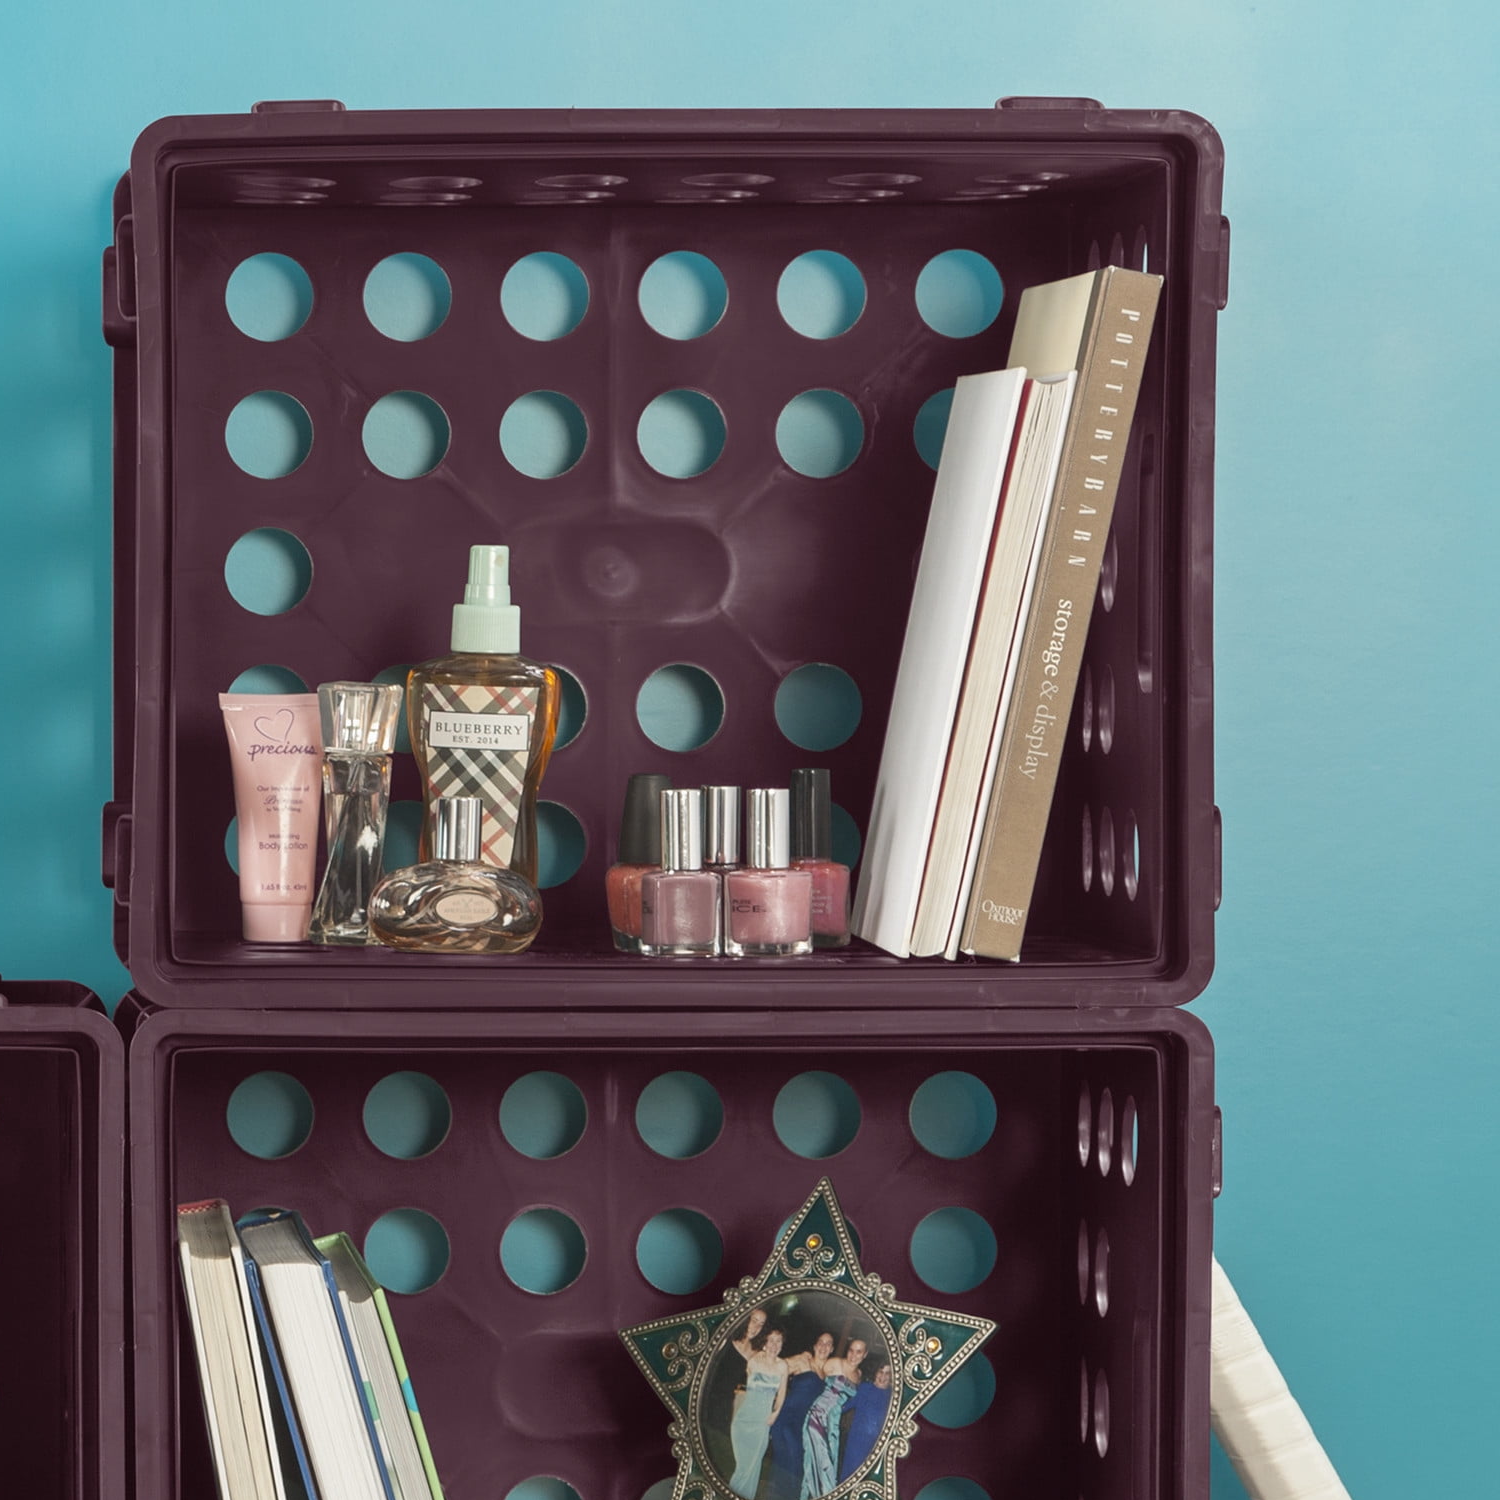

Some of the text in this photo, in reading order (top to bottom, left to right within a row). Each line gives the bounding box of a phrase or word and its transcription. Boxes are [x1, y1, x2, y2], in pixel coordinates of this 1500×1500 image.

[1018, 598, 1073, 780] storage & display
[435, 721, 523, 736] BLUEBERRY
[452, 735, 499, 745] EST. 2014
[247, 741, 318, 761] precious
[259, 841, 281, 852] Body
